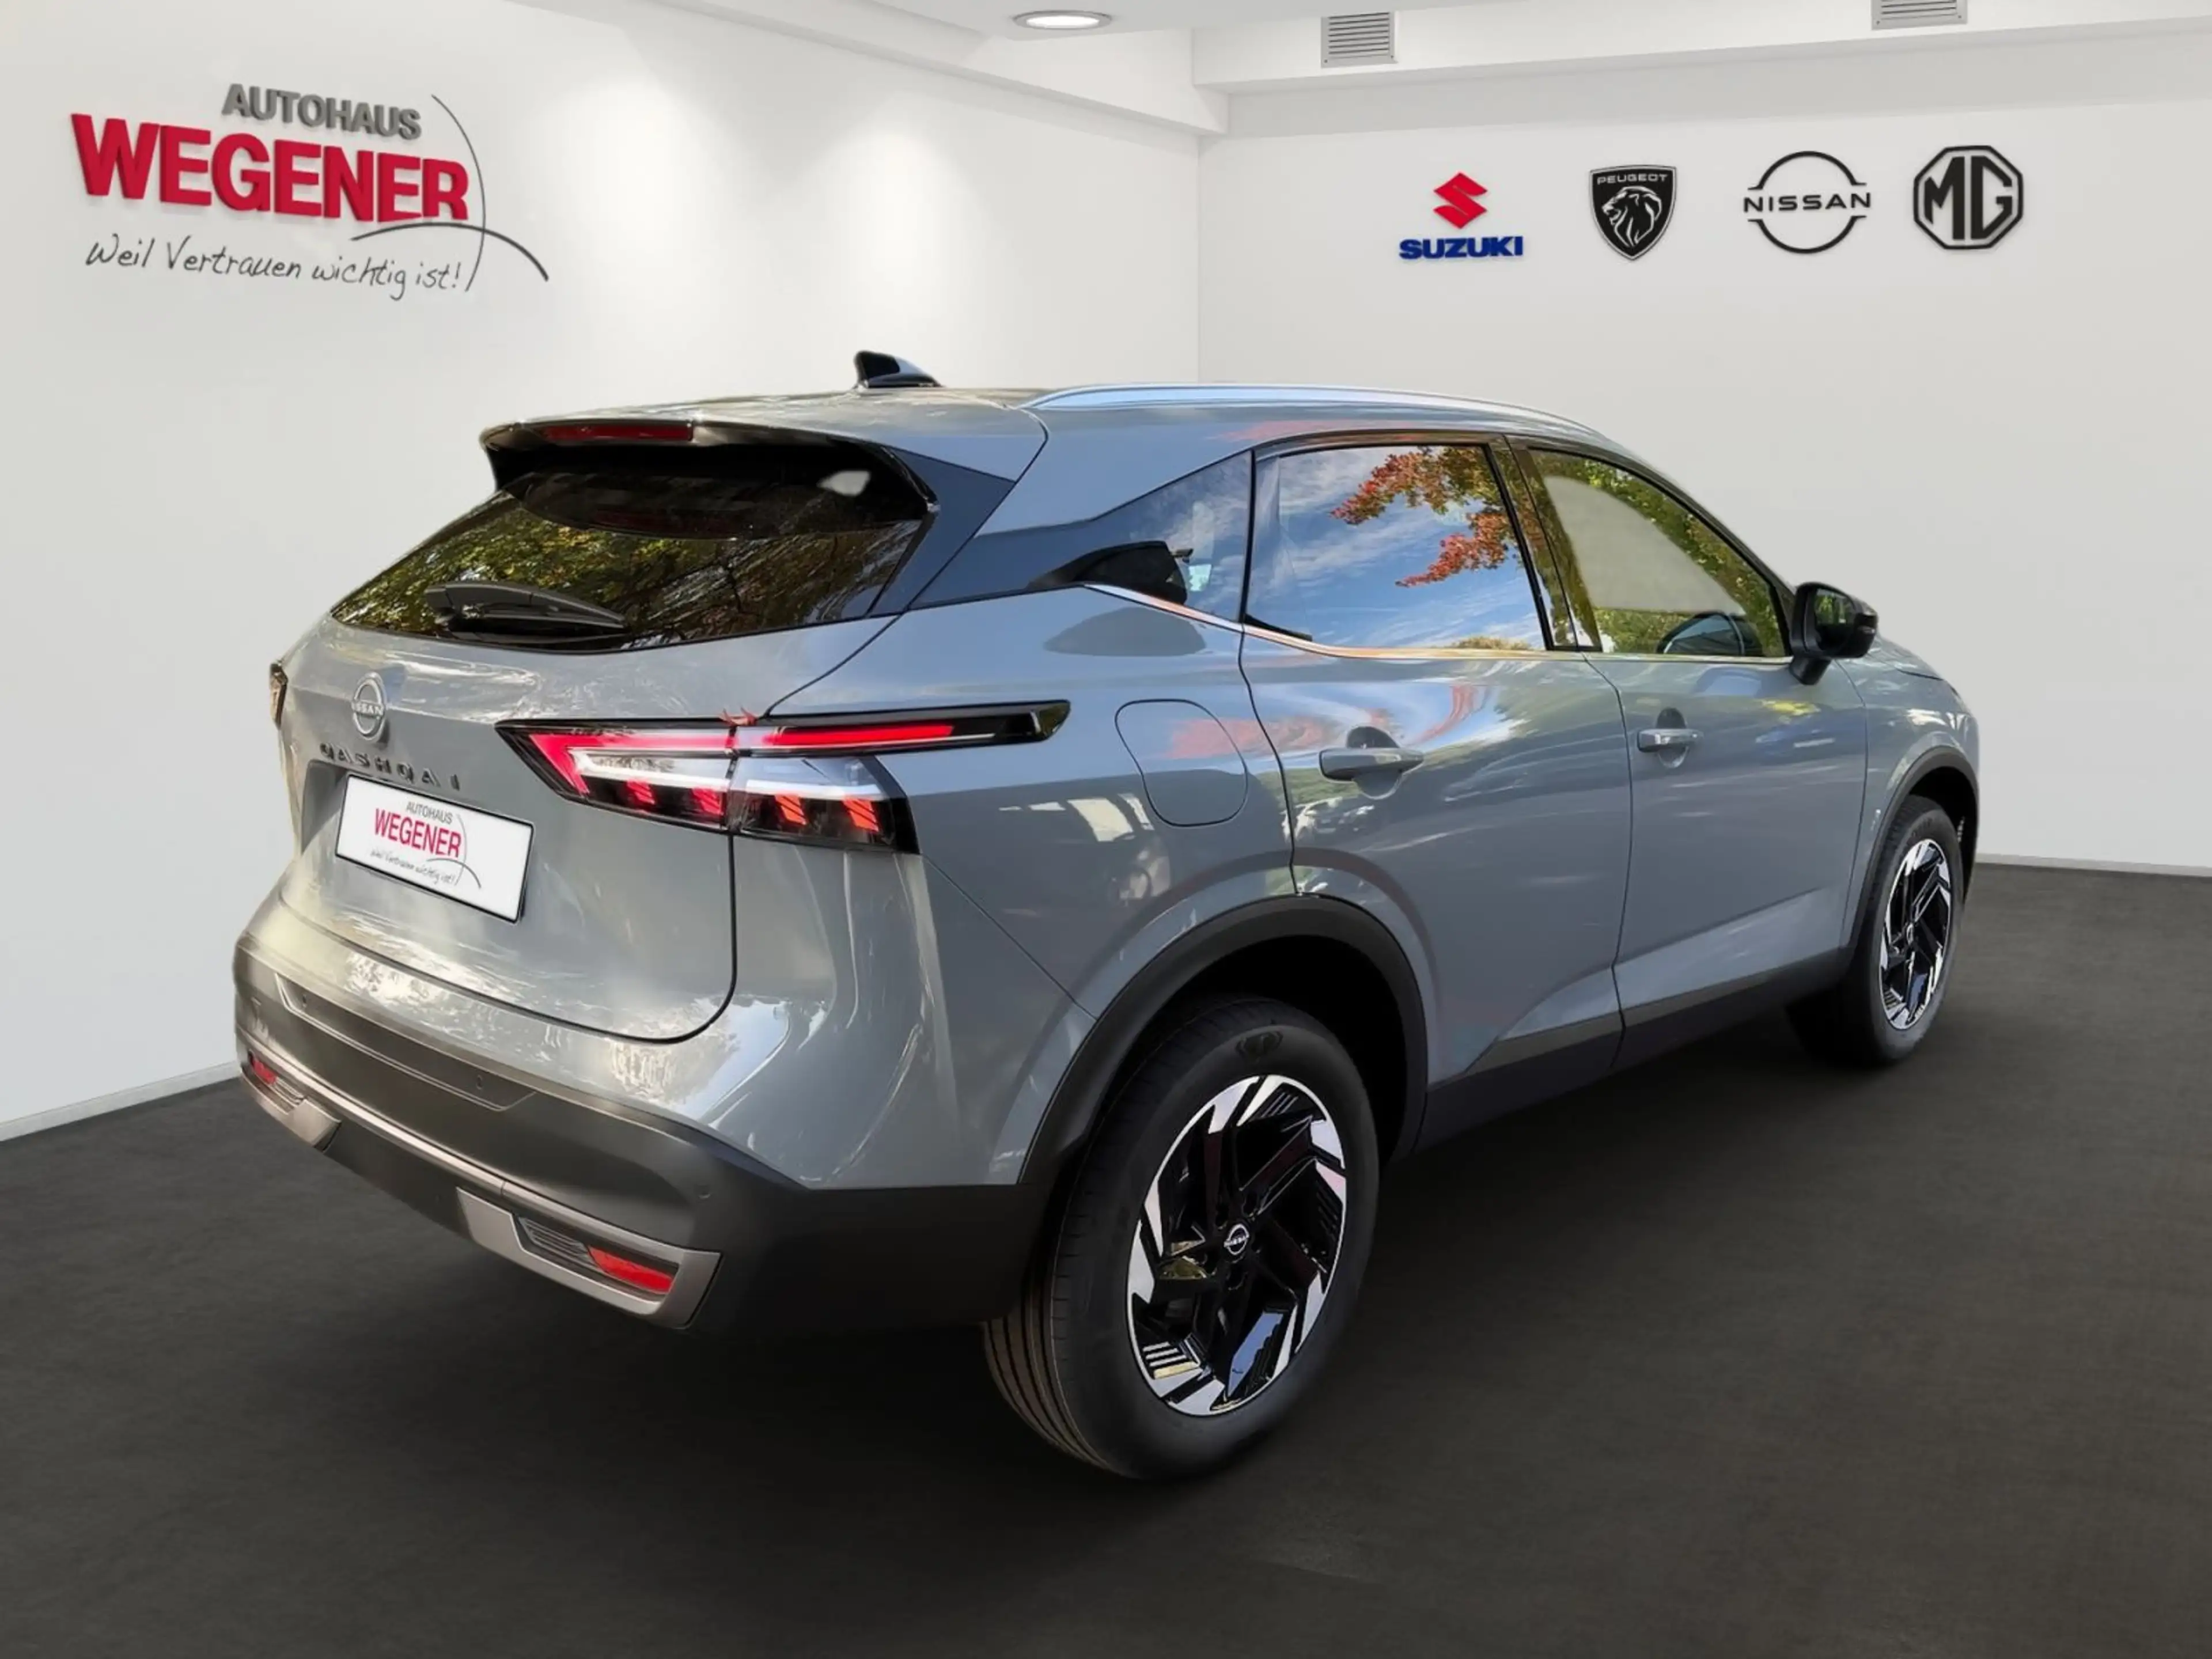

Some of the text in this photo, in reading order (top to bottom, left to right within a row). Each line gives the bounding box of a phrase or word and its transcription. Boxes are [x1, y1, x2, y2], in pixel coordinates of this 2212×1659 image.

[222, 84, 422, 140] AUTOHAUS
[71, 113, 469, 222] WEGENER
[1597, 173, 1668, 184] PEUGEOT
[1744, 193, 1871, 213] NISSAN
[1924, 156, 2013, 240] MG
[86, 233, 461, 301] Weil Vertrauen wichtig ist!
[1399, 236, 1524, 259] SUZUKI
[320, 743, 460, 791] QASHQAI
[375, 808, 461, 858] WEGENER
[406, 801, 453, 825] AUTOHAUS
